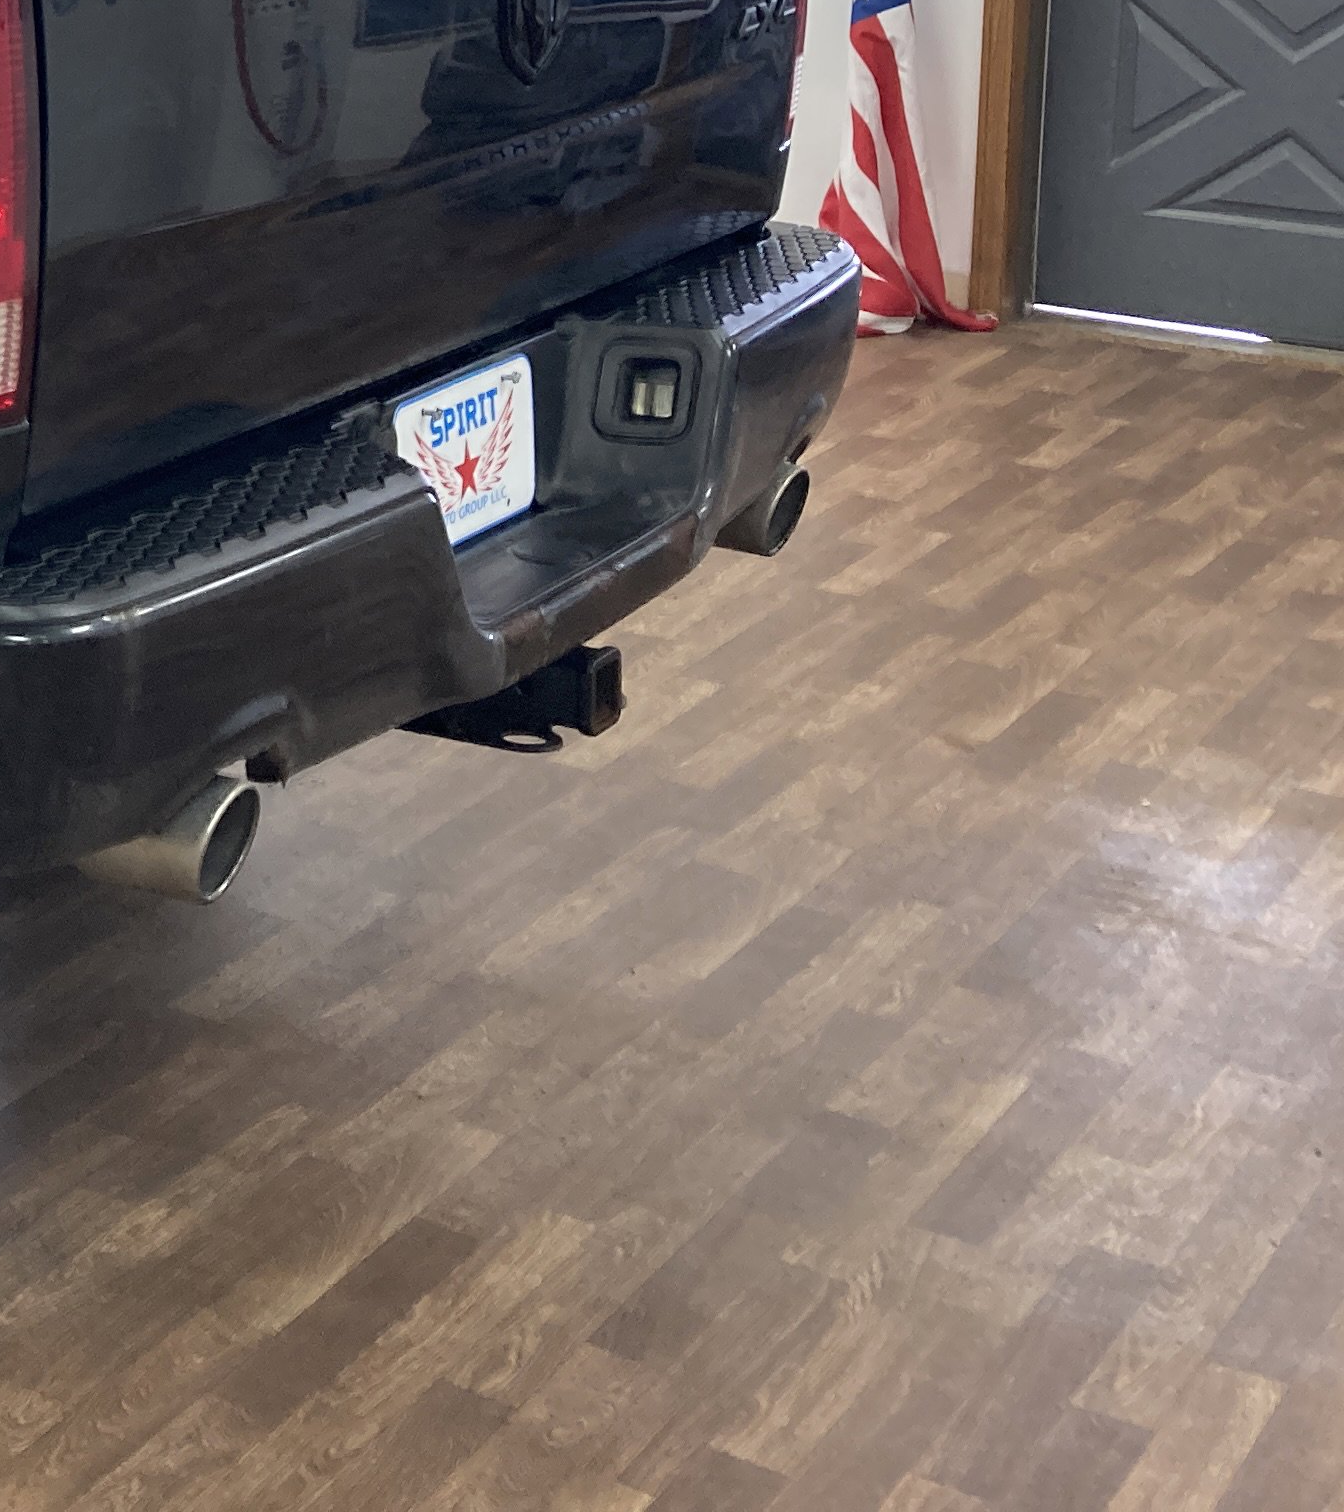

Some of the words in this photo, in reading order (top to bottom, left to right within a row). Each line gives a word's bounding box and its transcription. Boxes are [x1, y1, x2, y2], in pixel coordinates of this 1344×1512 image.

[429, 387, 499, 448] SPIRIT
[458, 494, 489, 518] GROUP
[491, 485, 508, 506] LLC
